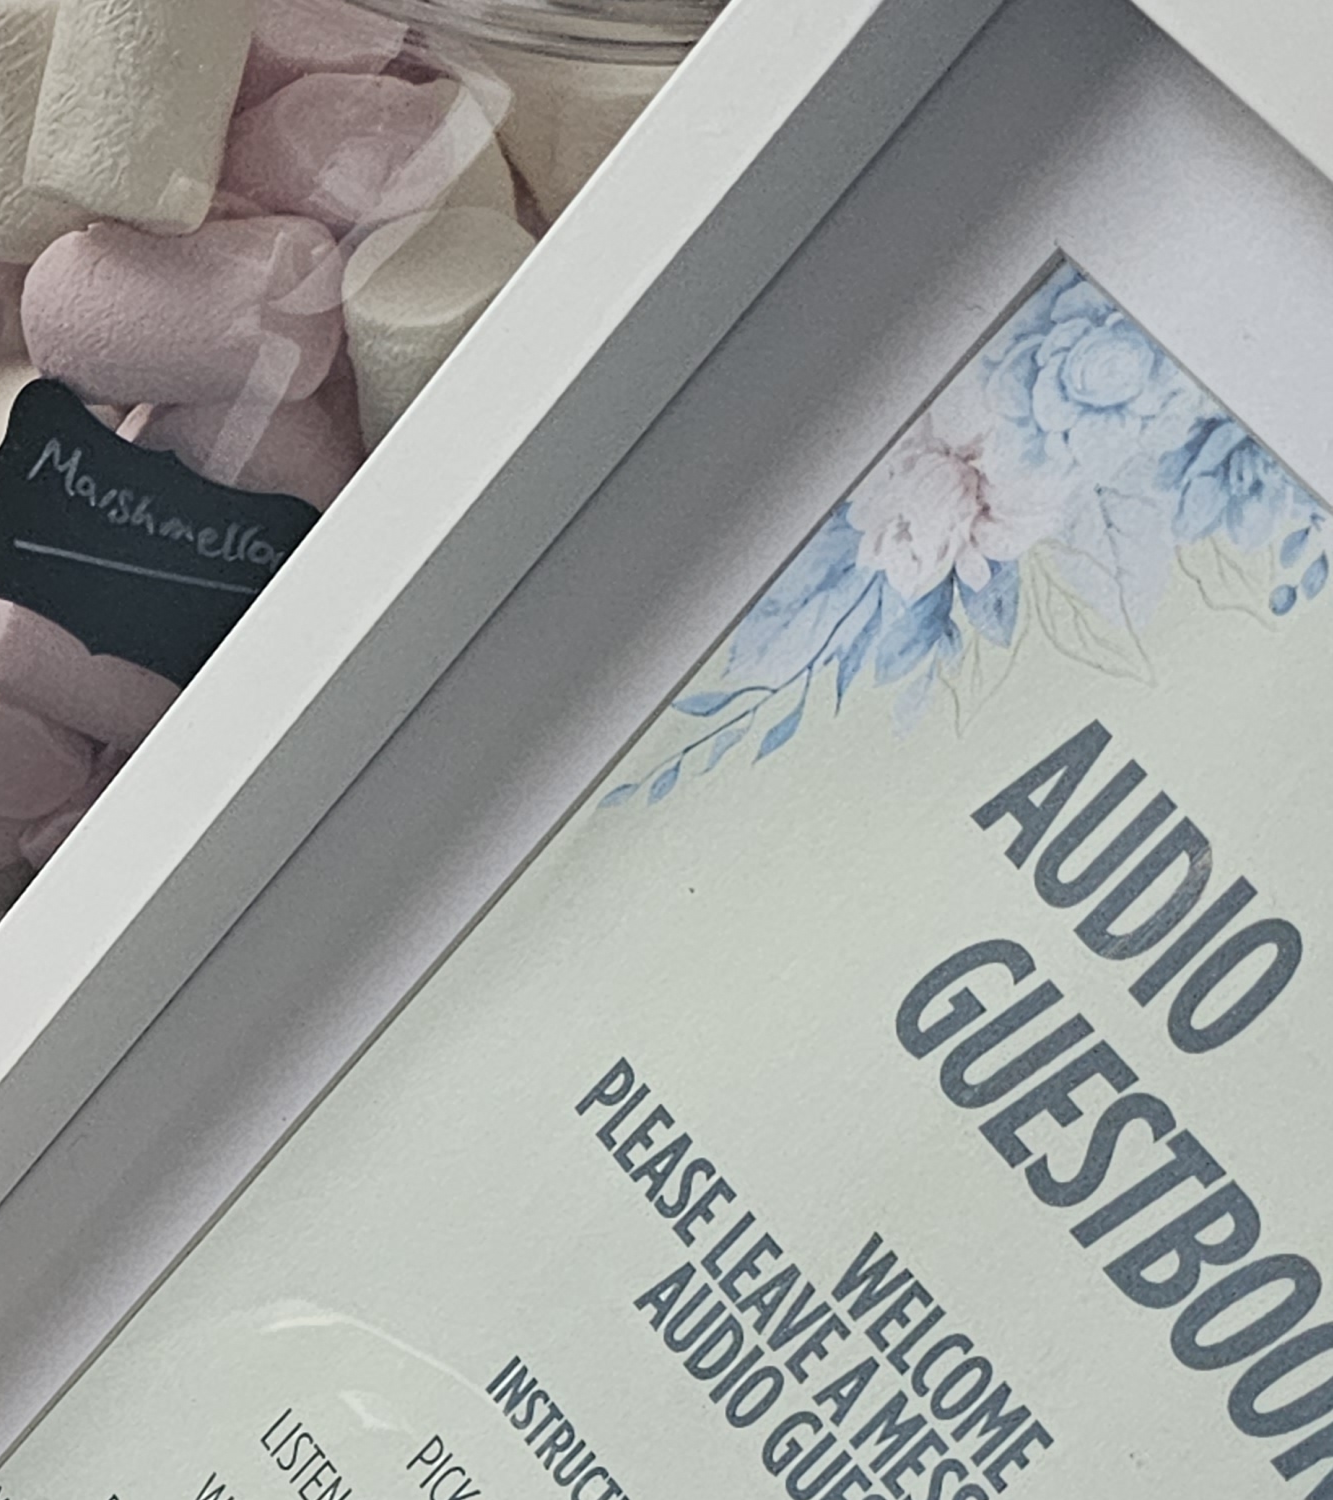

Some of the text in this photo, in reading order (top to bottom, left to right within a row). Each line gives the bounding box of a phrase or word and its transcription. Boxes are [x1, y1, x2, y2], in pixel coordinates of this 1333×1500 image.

[28, 438, 286, 573] Marshmello
[969, 719, 1303, 1055] AUDIO
[574, 1057, 737, 1248] PLEASE
[700, 1211, 851, 1384] LEAVE
[813, 1355, 880, 1426] A
[633, 1261, 784, 1428] AUDIO
[831, 1231, 1055, 1494] WELCOME
